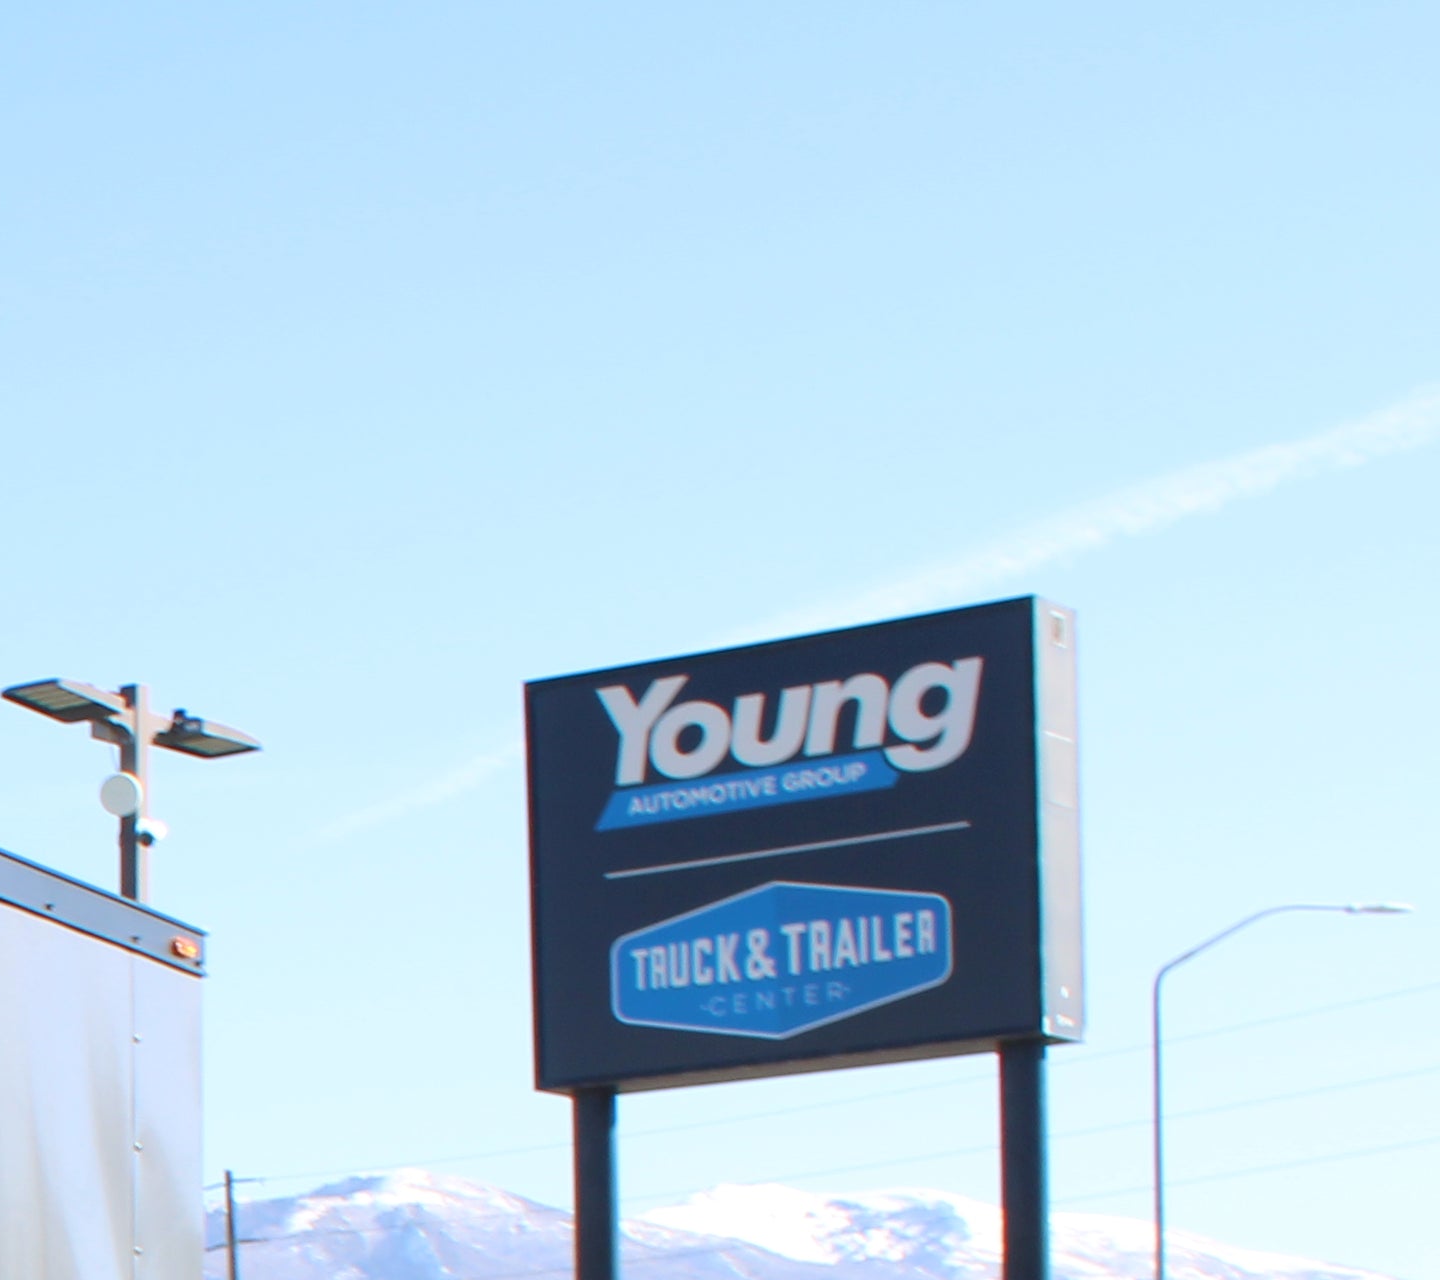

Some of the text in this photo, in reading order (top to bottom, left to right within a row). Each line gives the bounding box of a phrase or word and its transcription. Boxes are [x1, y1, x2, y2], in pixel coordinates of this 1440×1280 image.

[595, 656, 984, 788] Young
[627, 761, 870, 817] AUTOMOTIVE GROUP
[629, 907, 938, 992] TRUCK & TRAILER
